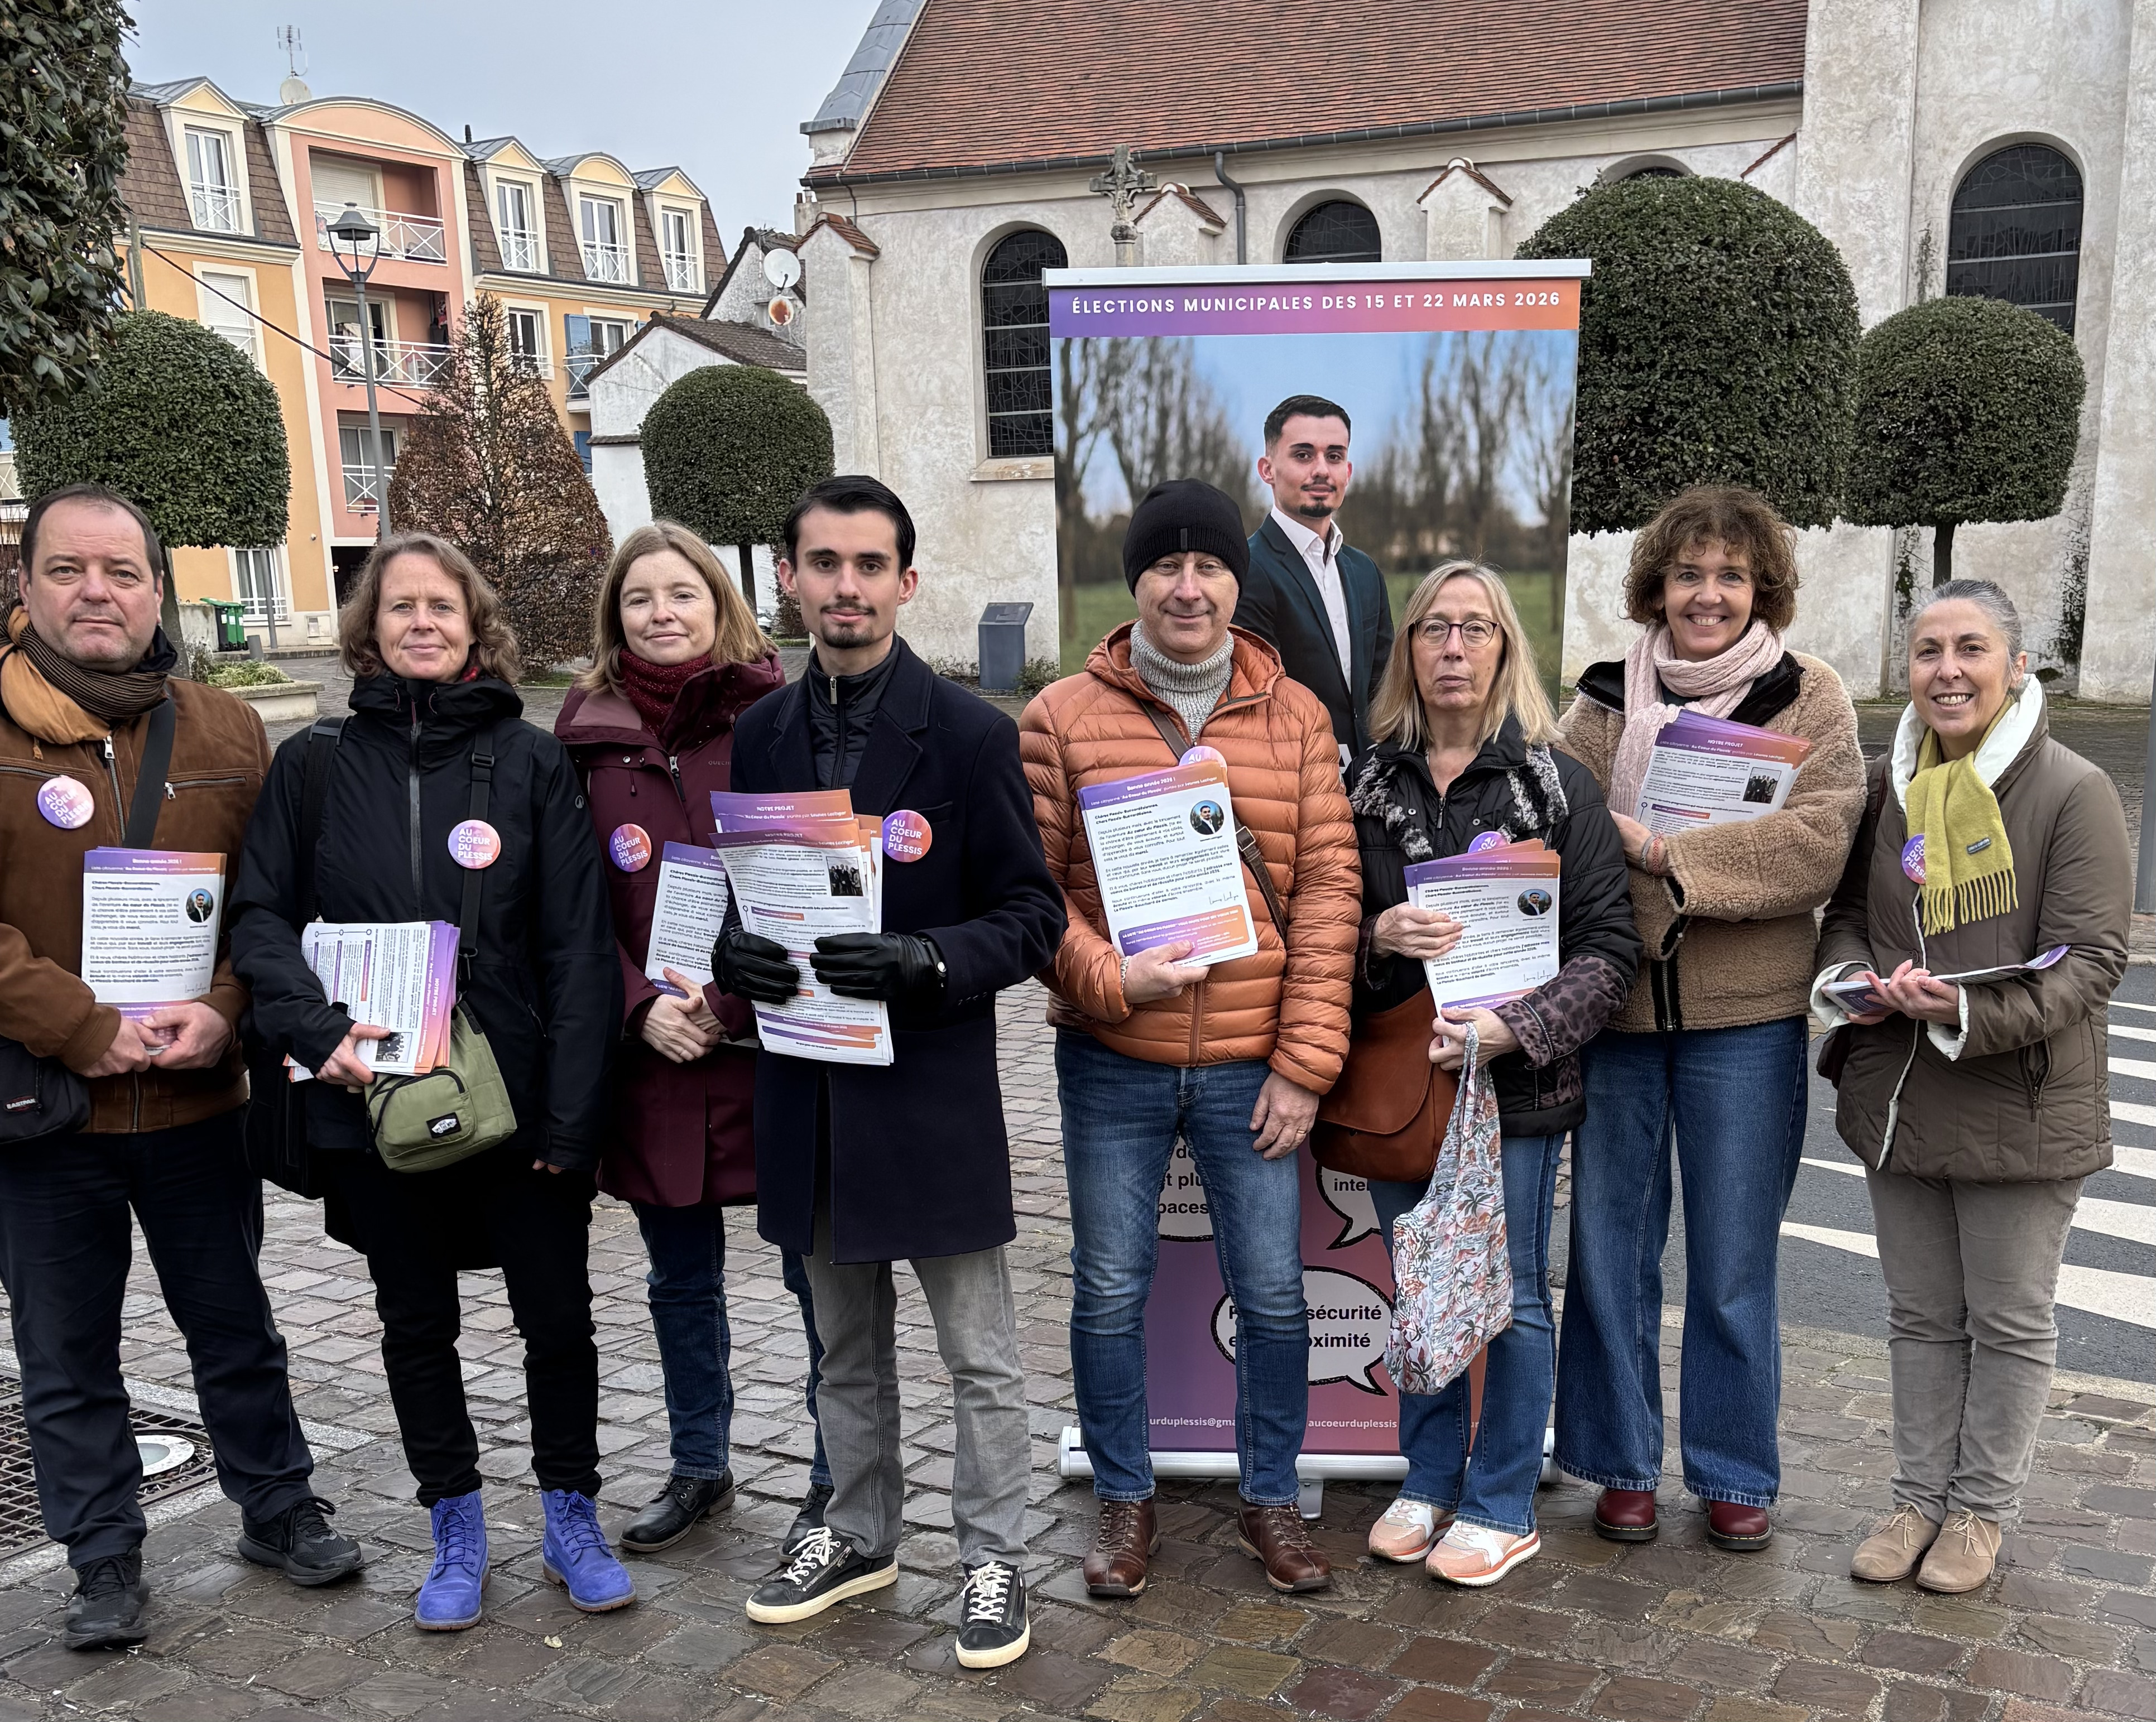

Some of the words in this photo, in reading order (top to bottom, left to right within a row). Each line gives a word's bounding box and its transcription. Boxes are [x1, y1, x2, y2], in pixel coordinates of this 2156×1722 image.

[1073, 297, 1174, 314] ÉLECTIONS
[1184, 297, 1312, 312] MUNICIPALES
[1322, 296, 1356, 309] DES
[1366, 295, 1384, 308] 15
[1395, 295, 1414, 307] ET
[1424, 295, 1443, 307] 22
[1453, 294, 1505, 306] MARS
[1515, 292, 1559, 306] 2026
[45, 792, 57, 805] AU
[55, 805, 69, 817] DU
[892, 819, 905, 827] AU
[889, 834, 902, 843] DU
[891, 826, 922, 839] COEUR
[459, 836, 490, 845] COEUR
[614, 835, 624, 845] AU
[616, 838, 641, 852] COEUR
[1918, 839, 1924, 848] A
[618, 850, 628, 859] DU
[888, 842, 922, 855] PLESSIS
[458, 851, 492, 860] PLESSIS
[621, 850, 648, 866] PLESSIS
[1909, 850, 1920, 862] DU
[1179, 1172, 1203, 1190] plu
[1159, 1203, 1209, 1214] paces
[1307, 1305, 1382, 1320] sécurité
[1309, 1333, 1371, 1347] ximité
[1150, 1417, 1235, 1427] urduplessis@gma
[1308, 1420, 1397, 1429] aucoeurduplessis
